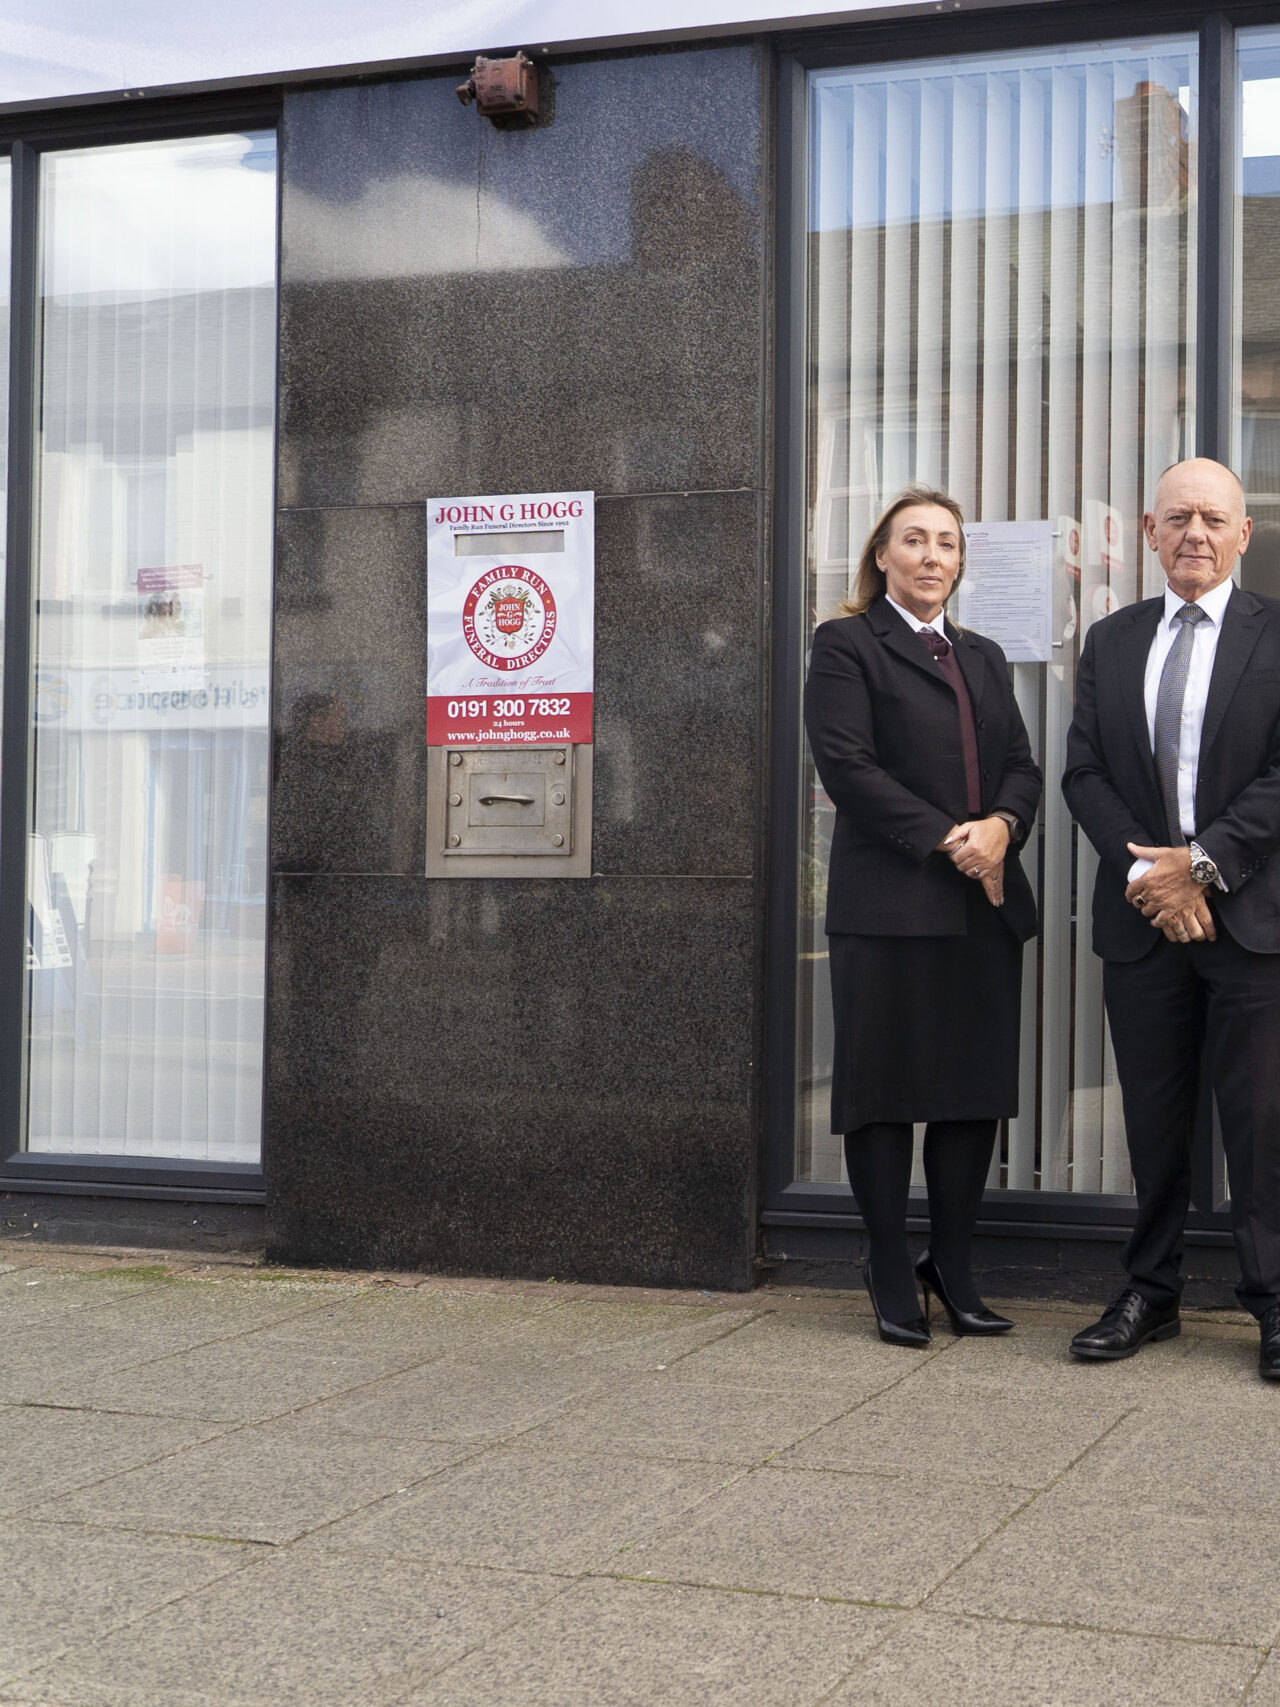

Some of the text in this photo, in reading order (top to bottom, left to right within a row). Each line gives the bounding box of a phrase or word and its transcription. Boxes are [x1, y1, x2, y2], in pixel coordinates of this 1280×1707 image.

[435, 501, 584, 524] JOHN G HOGG
[471, 567, 548, 598] FAMILY RUN
[498, 603, 520, 611] JOHN
[498, 618, 521, 626] HOGG
[506, 611, 513, 619] G
[464, 611, 556, 669] FUNERAL DIRECTORS
[475, 677, 517, 688] Tradition
[518, 676, 531, 689] of
[530, 675, 556, 686] Trust
[447, 698, 571, 718] 0191 300 7832
[493, 719, 525, 728] 24 hours
[447, 728, 571, 742] www.johnghogg.co.uk
